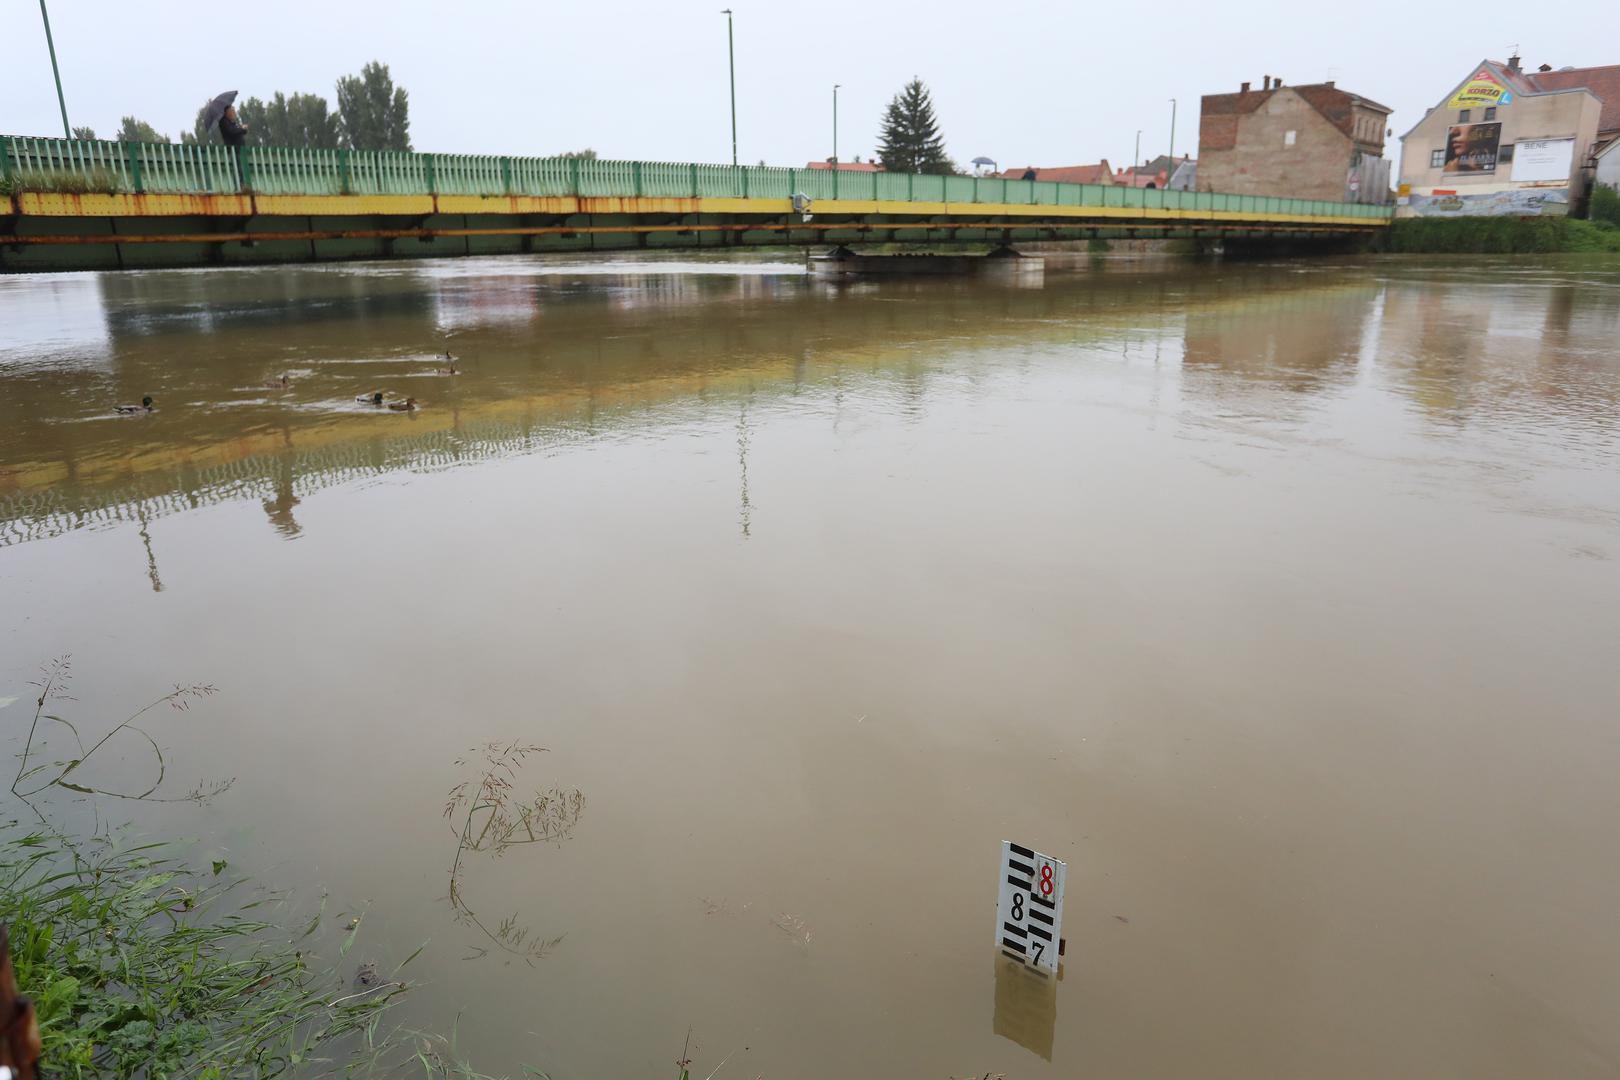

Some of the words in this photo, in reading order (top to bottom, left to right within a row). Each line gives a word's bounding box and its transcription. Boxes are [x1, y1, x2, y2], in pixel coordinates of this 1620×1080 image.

[1467, 88, 1501, 98] KORZO
[1040, 865, 1053, 896] 8
[1011, 892, 1024, 921] 8
[1031, 940, 1045, 966] 7
